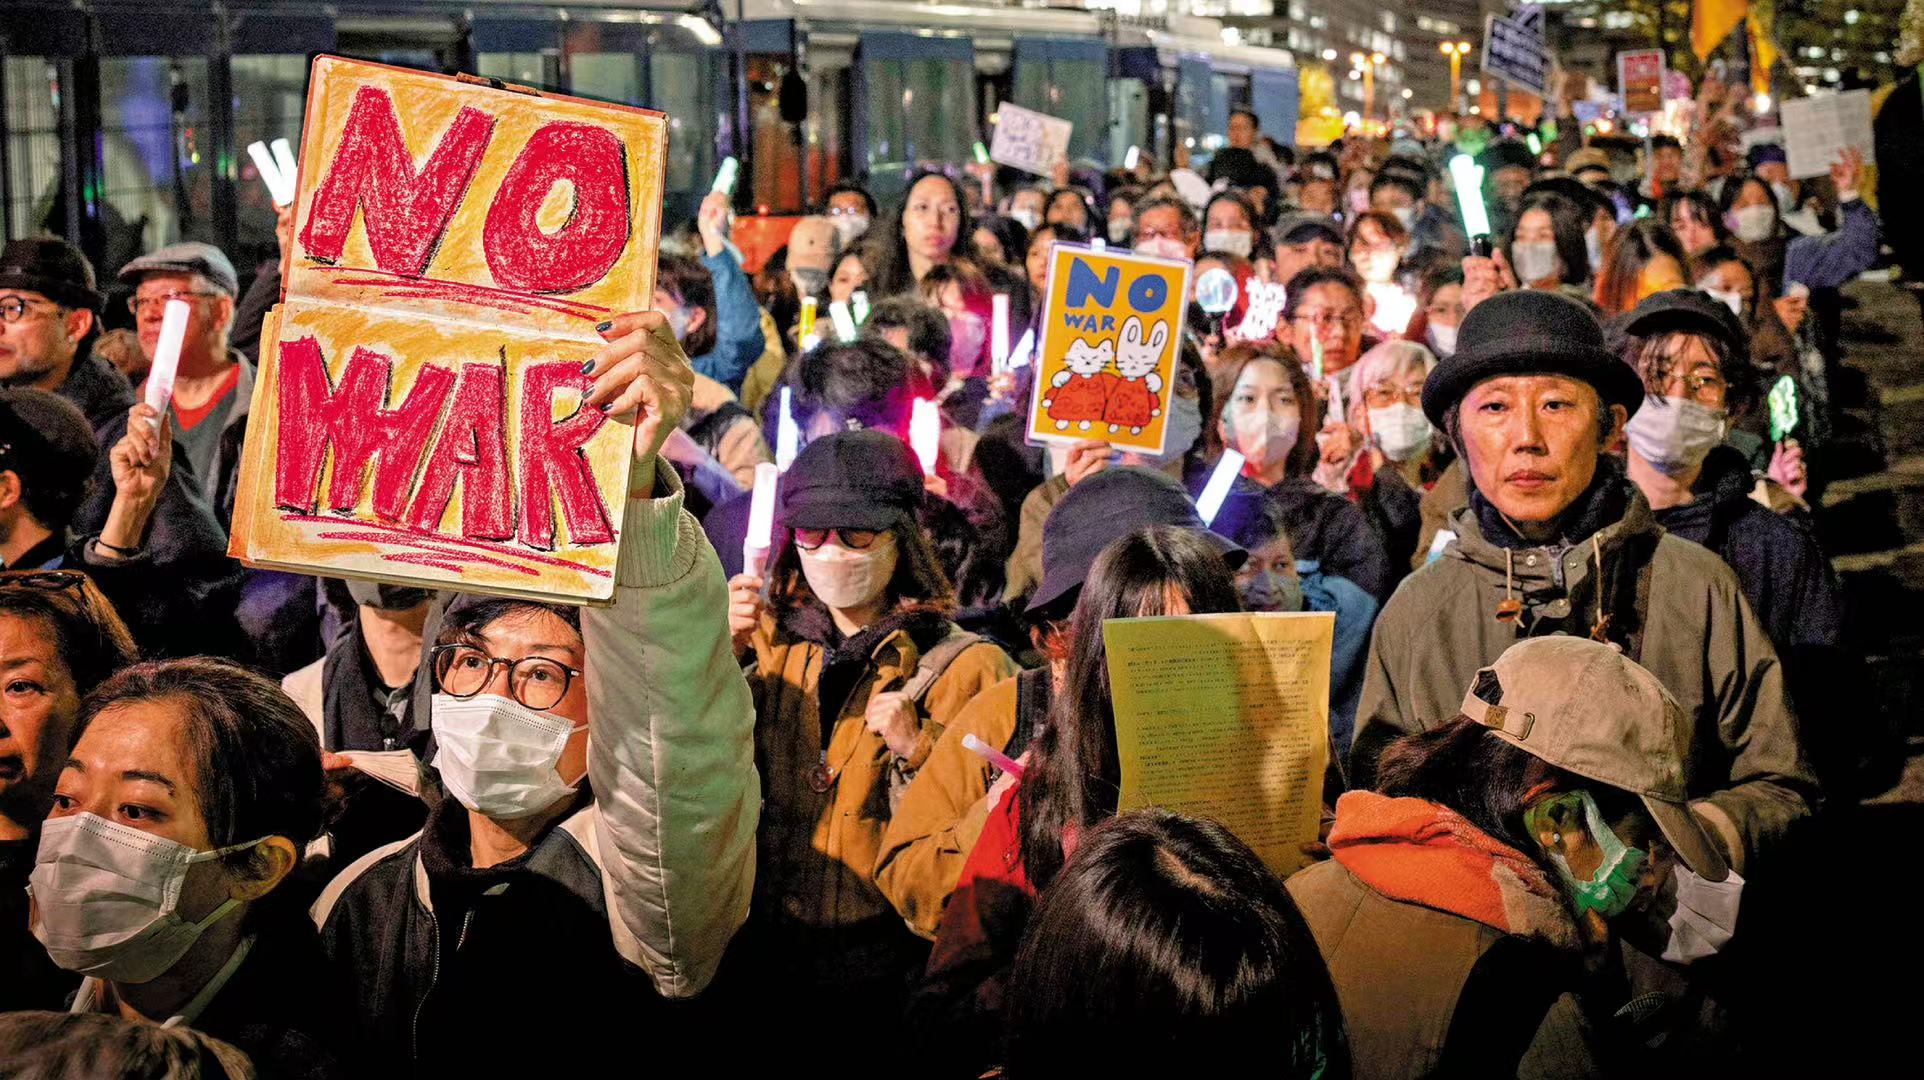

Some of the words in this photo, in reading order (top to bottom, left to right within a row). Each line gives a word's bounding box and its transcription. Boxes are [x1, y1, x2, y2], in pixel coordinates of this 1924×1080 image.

[299, 85, 632, 295] NO
[1064, 312, 1115, 333] WAR
[1066, 257, 1168, 312] NO
[274, 335, 618, 551] WAR
